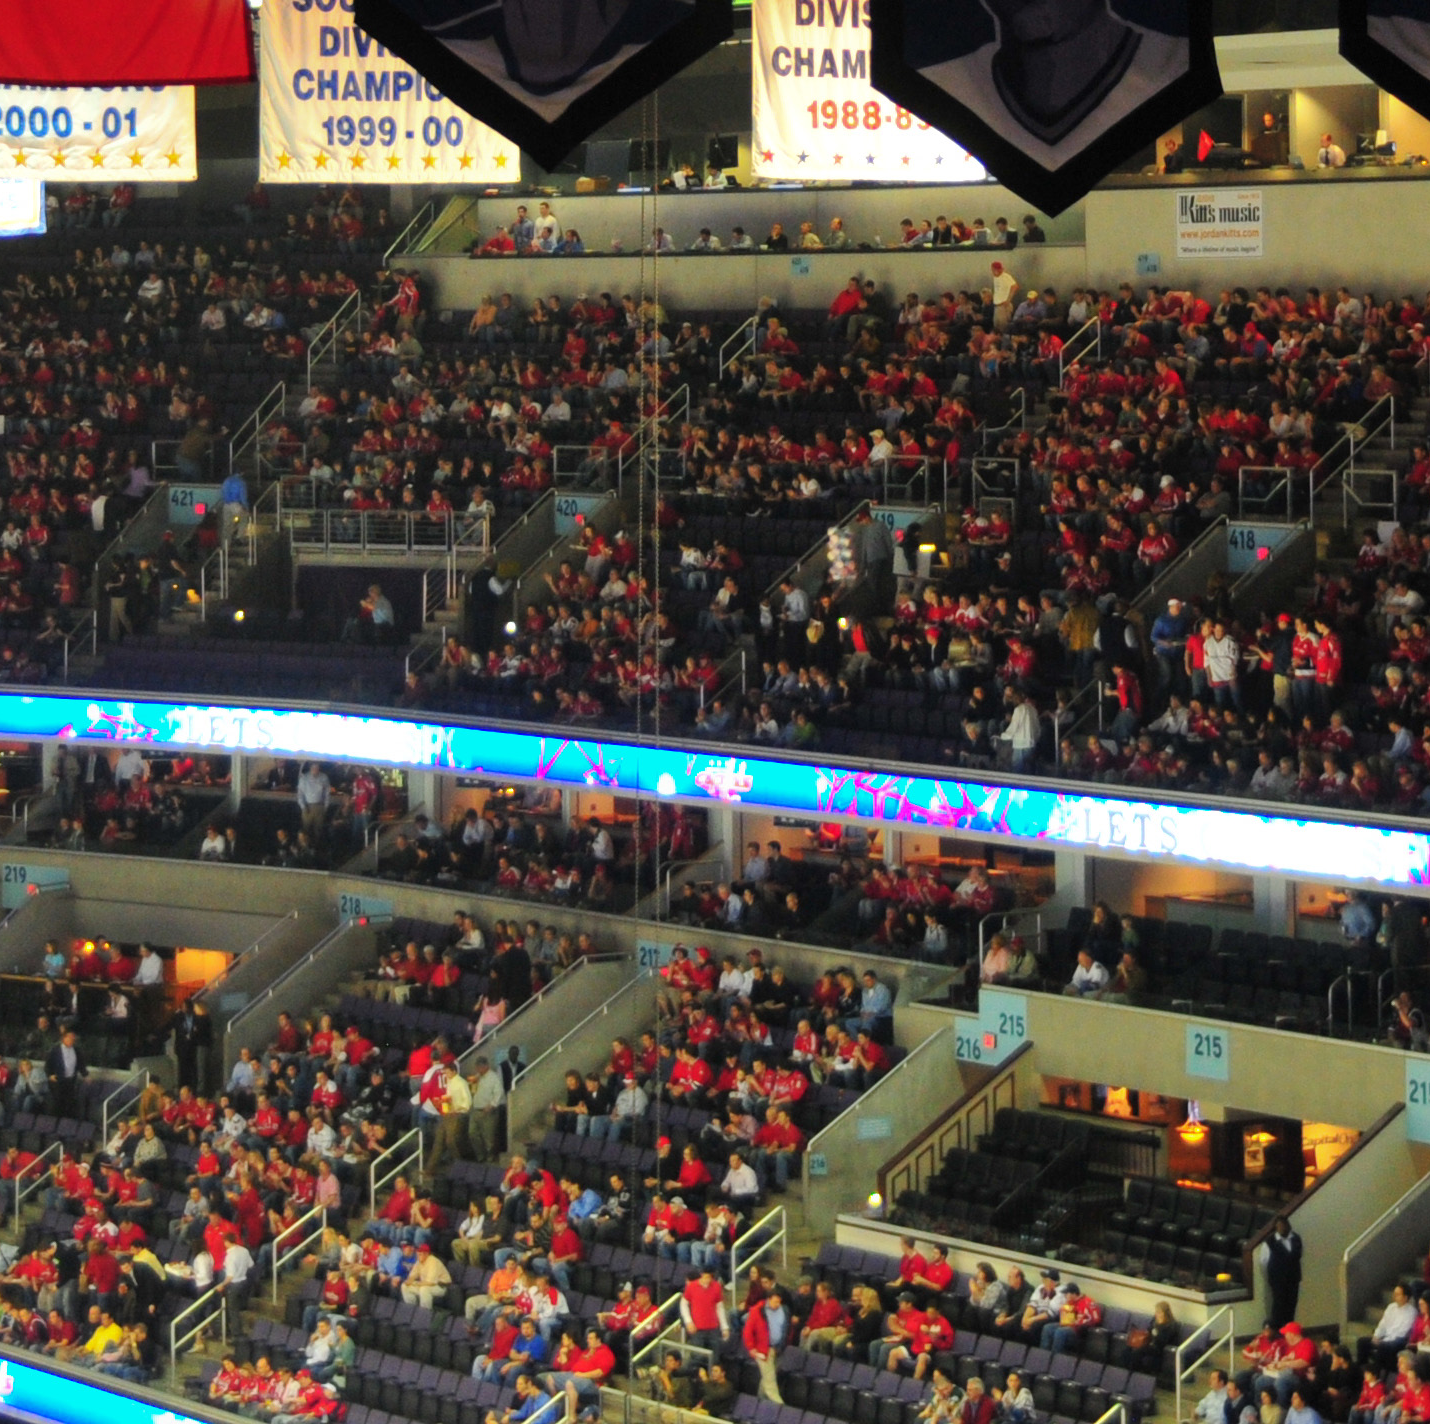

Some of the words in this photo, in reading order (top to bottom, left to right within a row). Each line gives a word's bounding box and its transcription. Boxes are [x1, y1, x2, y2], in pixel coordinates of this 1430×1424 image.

[771, 46, 871, 80] CHAM
[1218, 203, 1260, 223] music
[171, 489, 194, 507] 421
[556, 498, 578, 516] 420
[1229, 528, 1255, 550] 418
[4, 865, 27, 884] 219
[341, 895, 361, 916] 218
[998, 1012, 1025, 1038] 215
[956, 1036, 981, 1060] 216
[1194, 1032, 1222, 1059] 215
